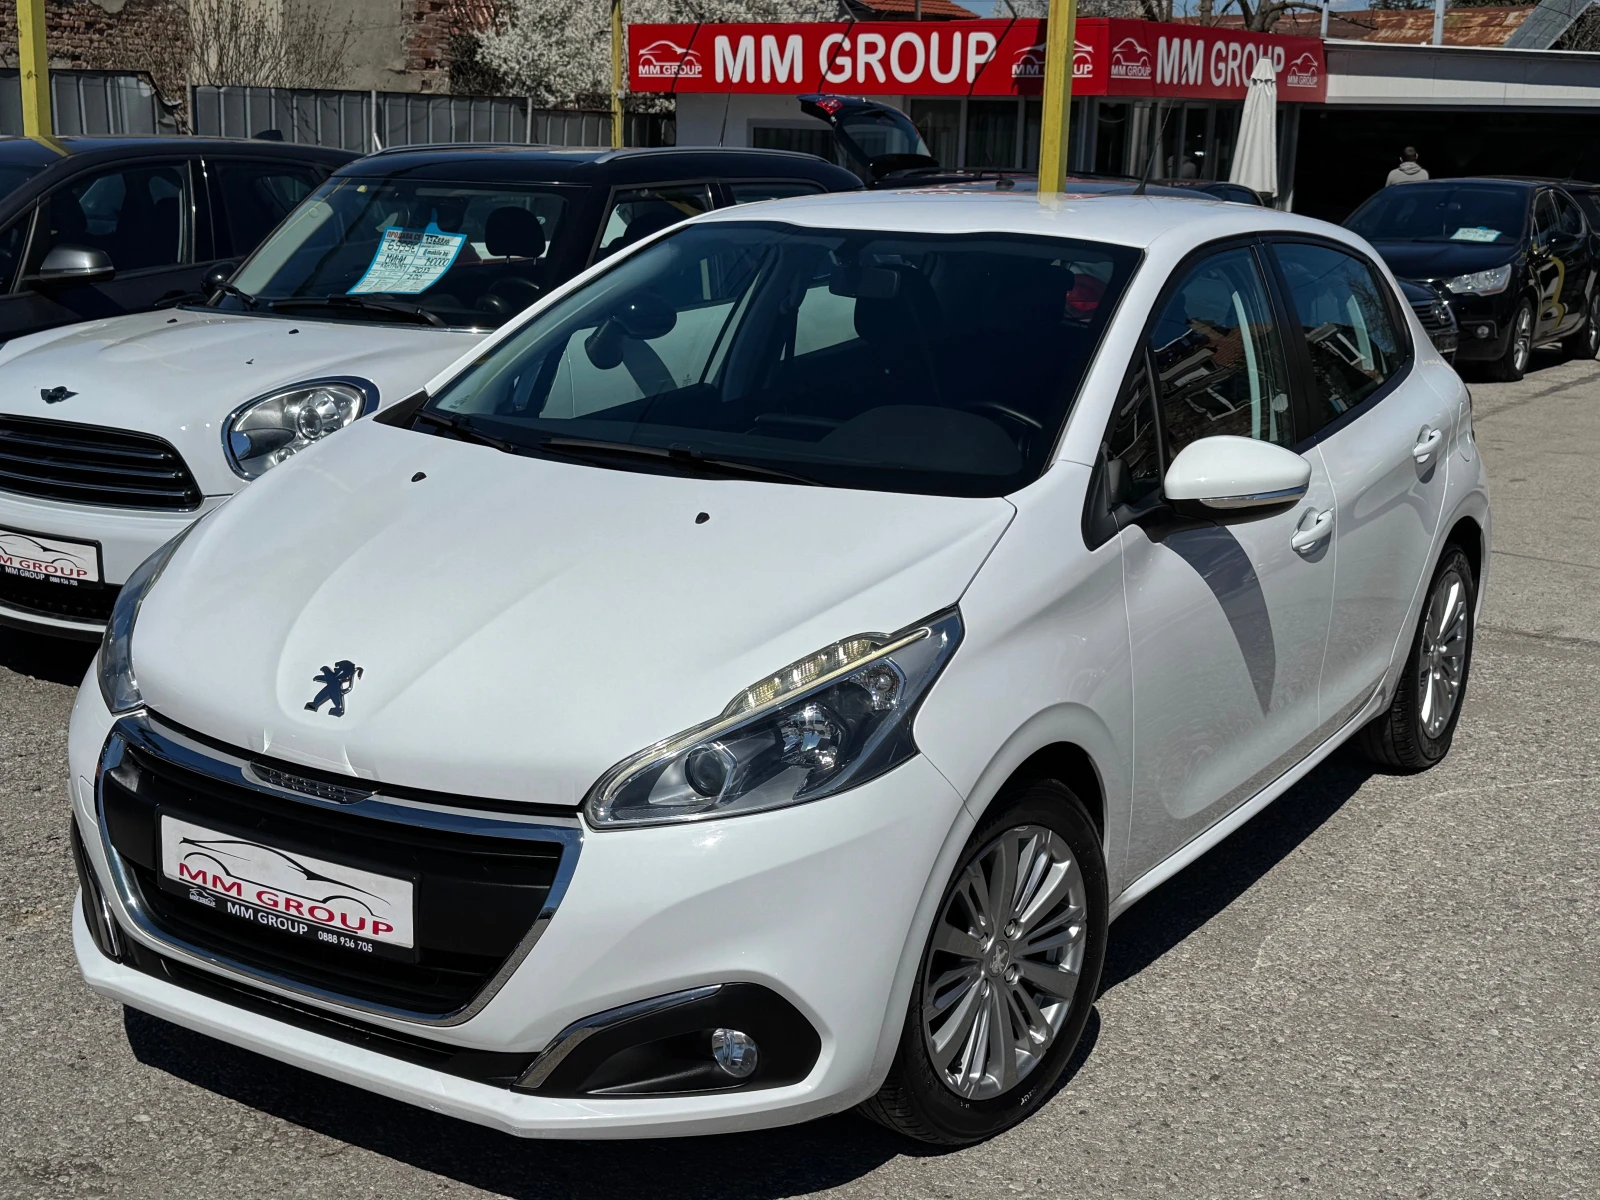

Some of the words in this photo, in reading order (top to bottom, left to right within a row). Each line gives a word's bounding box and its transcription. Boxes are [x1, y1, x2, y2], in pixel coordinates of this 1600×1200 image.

[714, 34, 803, 84] MM
[818, 31, 997, 84] GROUP
[1156, 36, 1205, 86] MM
[638, 65, 660, 75] MM
[663, 65, 702, 75] GROUP
[1011, 64, 1039, 75] MM
[1111, 65, 1126, 75] MM
[1126, 66, 1152, 77] GROUP
[1287, 75, 1299, 84] MM
[1299, 76, 1318, 86] GROUP
[5, 566, 19, 576] MM
[20, 569, 45, 581] GROUP
[19, 559, 88, 577] GROUP
[179, 862, 242, 897] MM
[256, 890, 394, 935] GROUP
[227, 901, 254, 921] MM
[258, 912, 308, 935] GROUP
[317, 930, 338, 945] 0888
[339, 936, 356, 949] 936
[357, 940, 373, 953] 705
